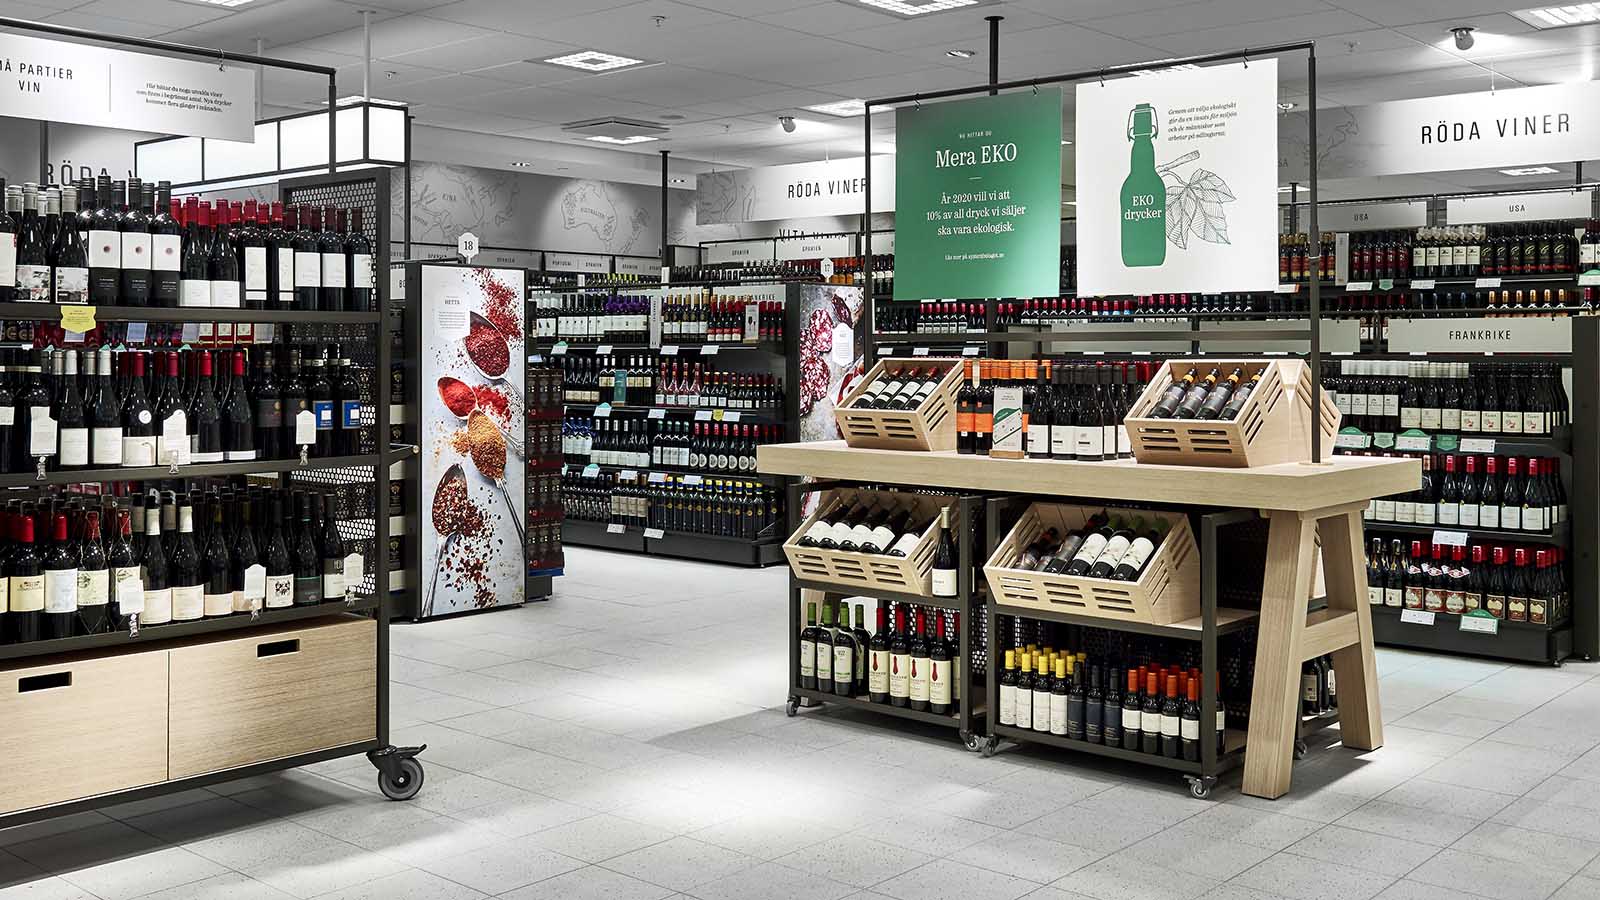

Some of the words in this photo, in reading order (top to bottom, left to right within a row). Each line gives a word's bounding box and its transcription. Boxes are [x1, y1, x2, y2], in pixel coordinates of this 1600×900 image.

[20, 62, 73, 80] PARTIER
[18, 80, 40, 93] VIN
[1421, 120, 1480, 144] RÖDA
[1496, 113, 1570, 137] VINER
[936, 150, 976, 168] Mera
[981, 142, 1017, 164] EKO
[788, 180, 820, 199] RÖDA
[828, 178, 866, 195] VINER
[941, 192, 951, 204] År
[953, 193, 971, 204] 2020
[973, 191, 986, 202] vill
[988, 190, 997, 201] vi
[998, 190, 1010, 200] att
[1132, 194, 1154, 206] EKO
[927, 210, 941, 220] 10%
[942, 212, 952, 220] av
[954, 208, 964, 219] all
[966, 207, 990, 220] dryck
[991, 206, 1000, 216] vi
[1001, 204, 1026, 217] säljer
[1124, 208, 1162, 221] drycker
[1509, 204, 1526, 212] USA
[1354, 213, 1369, 221] USA
[937, 225, 952, 236] ska
[953, 225, 971, 234] vara
[973, 221, 1015, 234] ekologisk.
[464, 240, 473, 250] 18
[1450, 330, 1511, 340] FRANKRIKE
